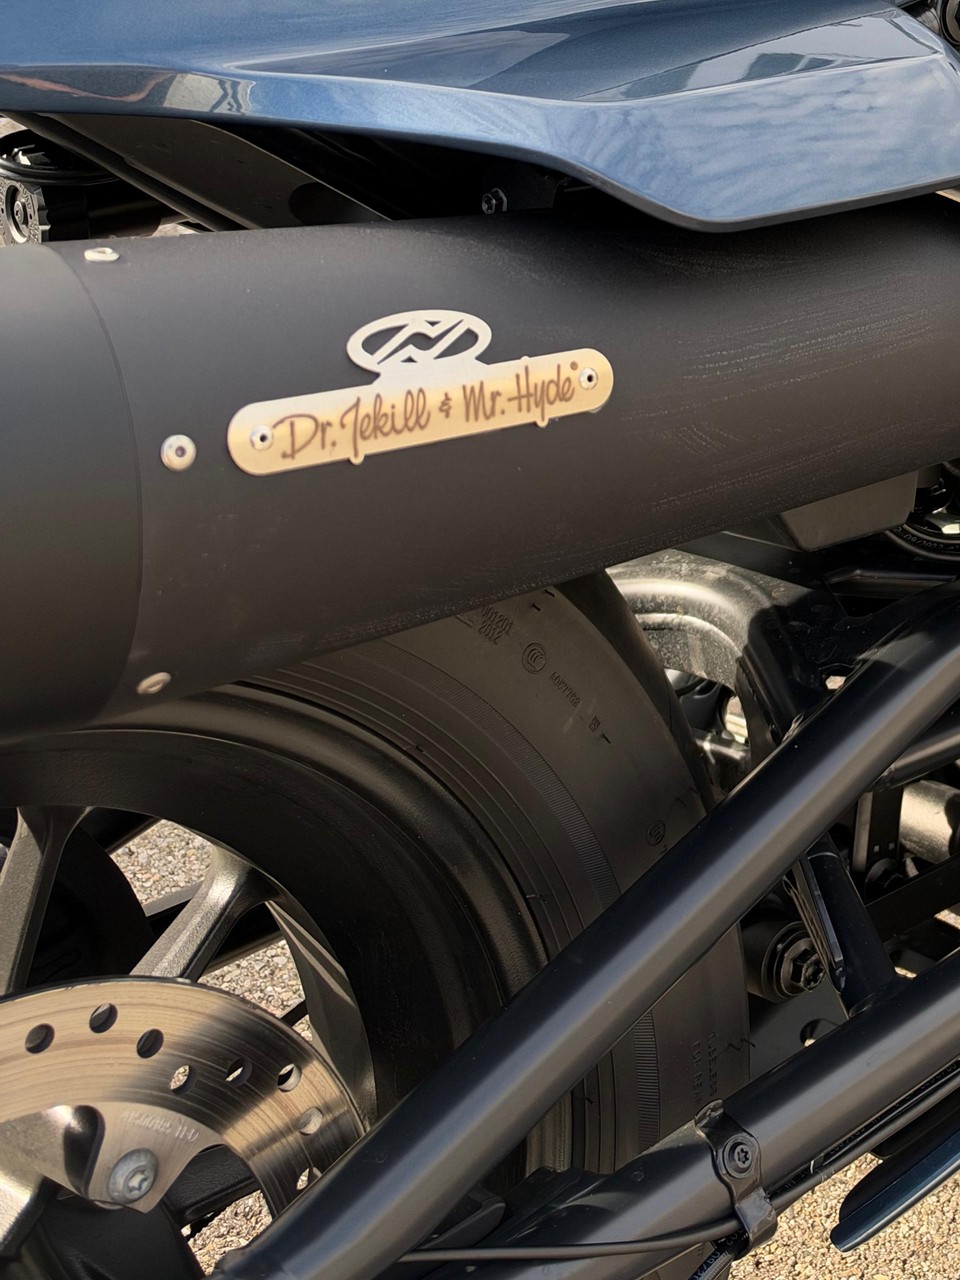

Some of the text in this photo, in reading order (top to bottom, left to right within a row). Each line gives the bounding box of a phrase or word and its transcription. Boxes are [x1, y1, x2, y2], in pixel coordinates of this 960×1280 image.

[272, 413, 337, 460] Dr.
[339, 388, 431, 457] Jekill
[438, 394, 452, 419] &
[462, 380, 505, 422] Mr.
